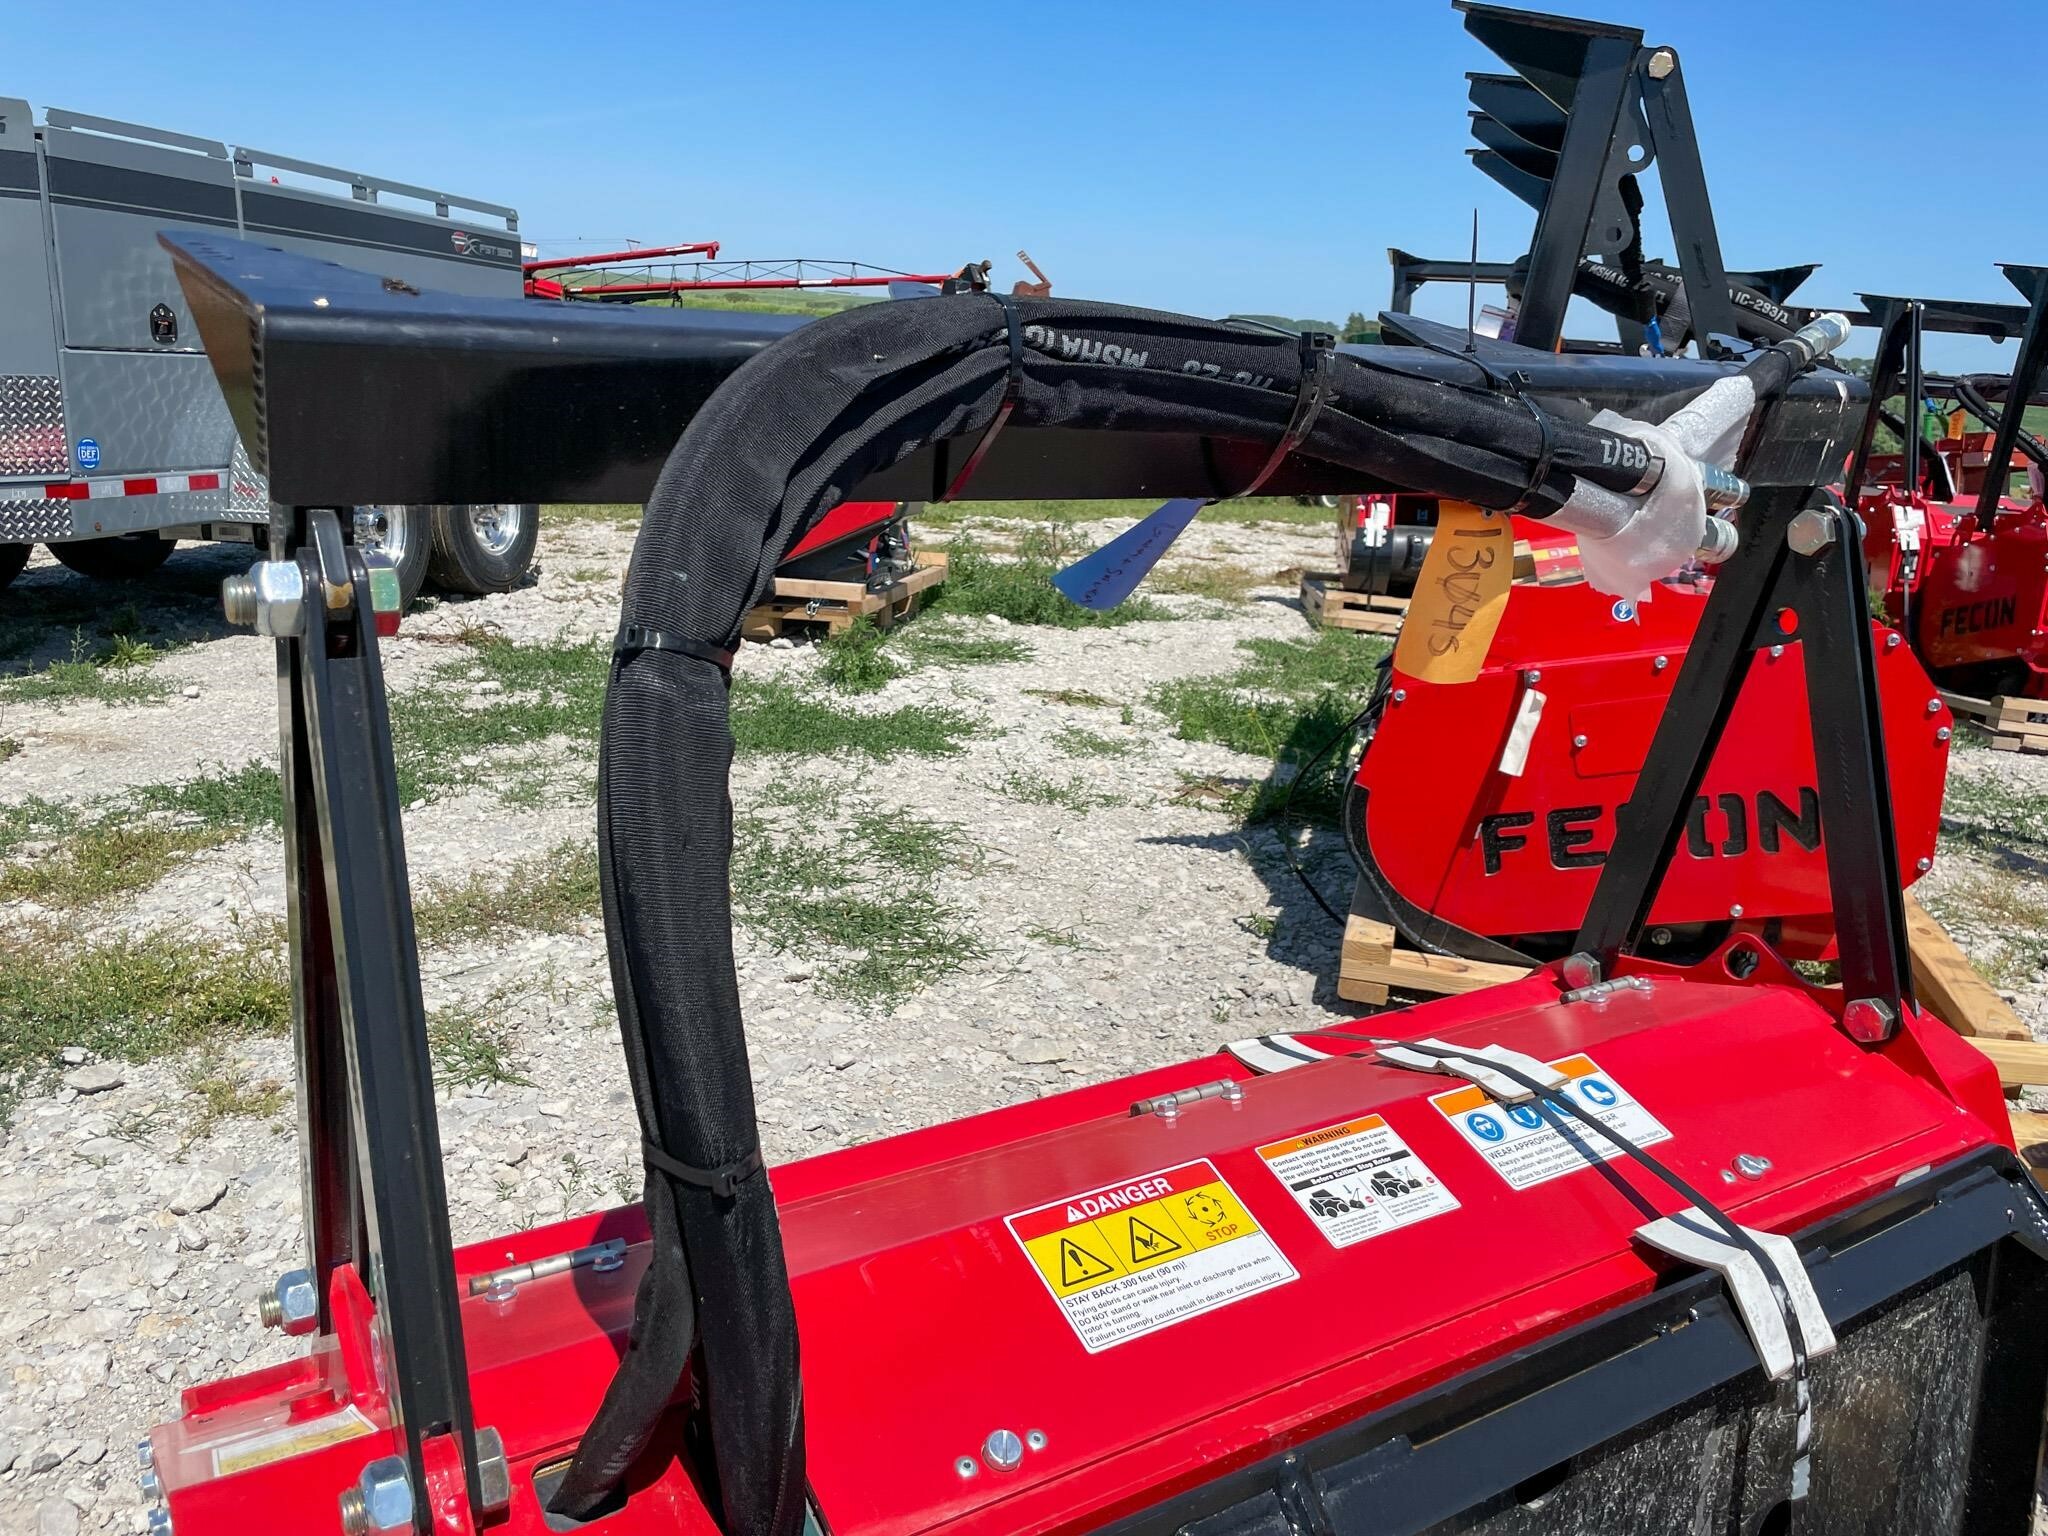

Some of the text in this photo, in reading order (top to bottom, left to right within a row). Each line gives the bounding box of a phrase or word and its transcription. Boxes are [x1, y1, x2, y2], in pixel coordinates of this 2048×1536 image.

[1735, 291, 1789, 324] IC-293/1
[81, 450, 97, 459] DEF
[1939, 598, 2017, 637] FECON
[1479, 786, 1821, 876] FEON
[1271, 1155, 1300, 1167] Contact
[1298, 1151, 1315, 1159] with
[1314, 1144, 1340, 1155] moving
[1338, 1139, 1356, 1147] rotor
[1368, 1130, 1388, 1138] cause
[1301, 1126, 1351, 1145] WARNING
[1487, 1146, 1514, 1159] WEAR
[1511, 1129, 1567, 1151] APPROPRIATE
[1563, 1122, 1589, 1134] SAFE
[1597, 1112, 1619, 1123] EAR
[1277, 1163, 1303, 1174] serious
[1302, 1157, 1324, 1167] injury
[1330, 1148, 1352, 1158] death.
[1283, 1173, 1296, 1181] the
[1295, 1166, 1321, 1177] vehicle
[1319, 1159, 1342, 1169] before
[1353, 1151, 1371, 1159] rotor
[1369, 1144, 1391, 1154] stops.
[1310, 1156, 1392, 1185] Before Exiting Stop Rotor
[1078, 1176, 1174, 1216] DANGER
[1204, 1223, 1241, 1241] STOP
[1065, 1260, 1188, 1307] STAY BACK 300 feet (90 m)!
[1072, 1305, 1097, 1318] Flying
[1096, 1295, 1122, 1308] debris
[1136, 1284, 1158, 1295] cause
[1157, 1274, 1182, 1288] injury.
[1078, 1317, 1092, 1326] DO
[1091, 1310, 1110, 1322] NOT
[1109, 1303, 1131, 1315] stand
[1140, 1293, 1158, 1304] walk
[1158, 1288, 1176, 1298] near
[1175, 1281, 1193, 1292] inlet
[1201, 1266, 1237, 1284] discharge
[1236, 1262, 1252, 1270] area
[1250, 1254, 1271, 1265] when
[1083, 1323, 1102, 1334] rotor
[1111, 1309, 1142, 1325] turning.
[1089, 1329, 1116, 1344] Failure
[1123, 1315, 1155, 1332] comply
[1153, 1308, 1175, 1320] could
[1174, 1300, 1196, 1312] result
[1203, 1289, 1225, 1302] death
[1233, 1277, 1261, 1291] serious
[1259, 1269, 1283, 1283] injury.
